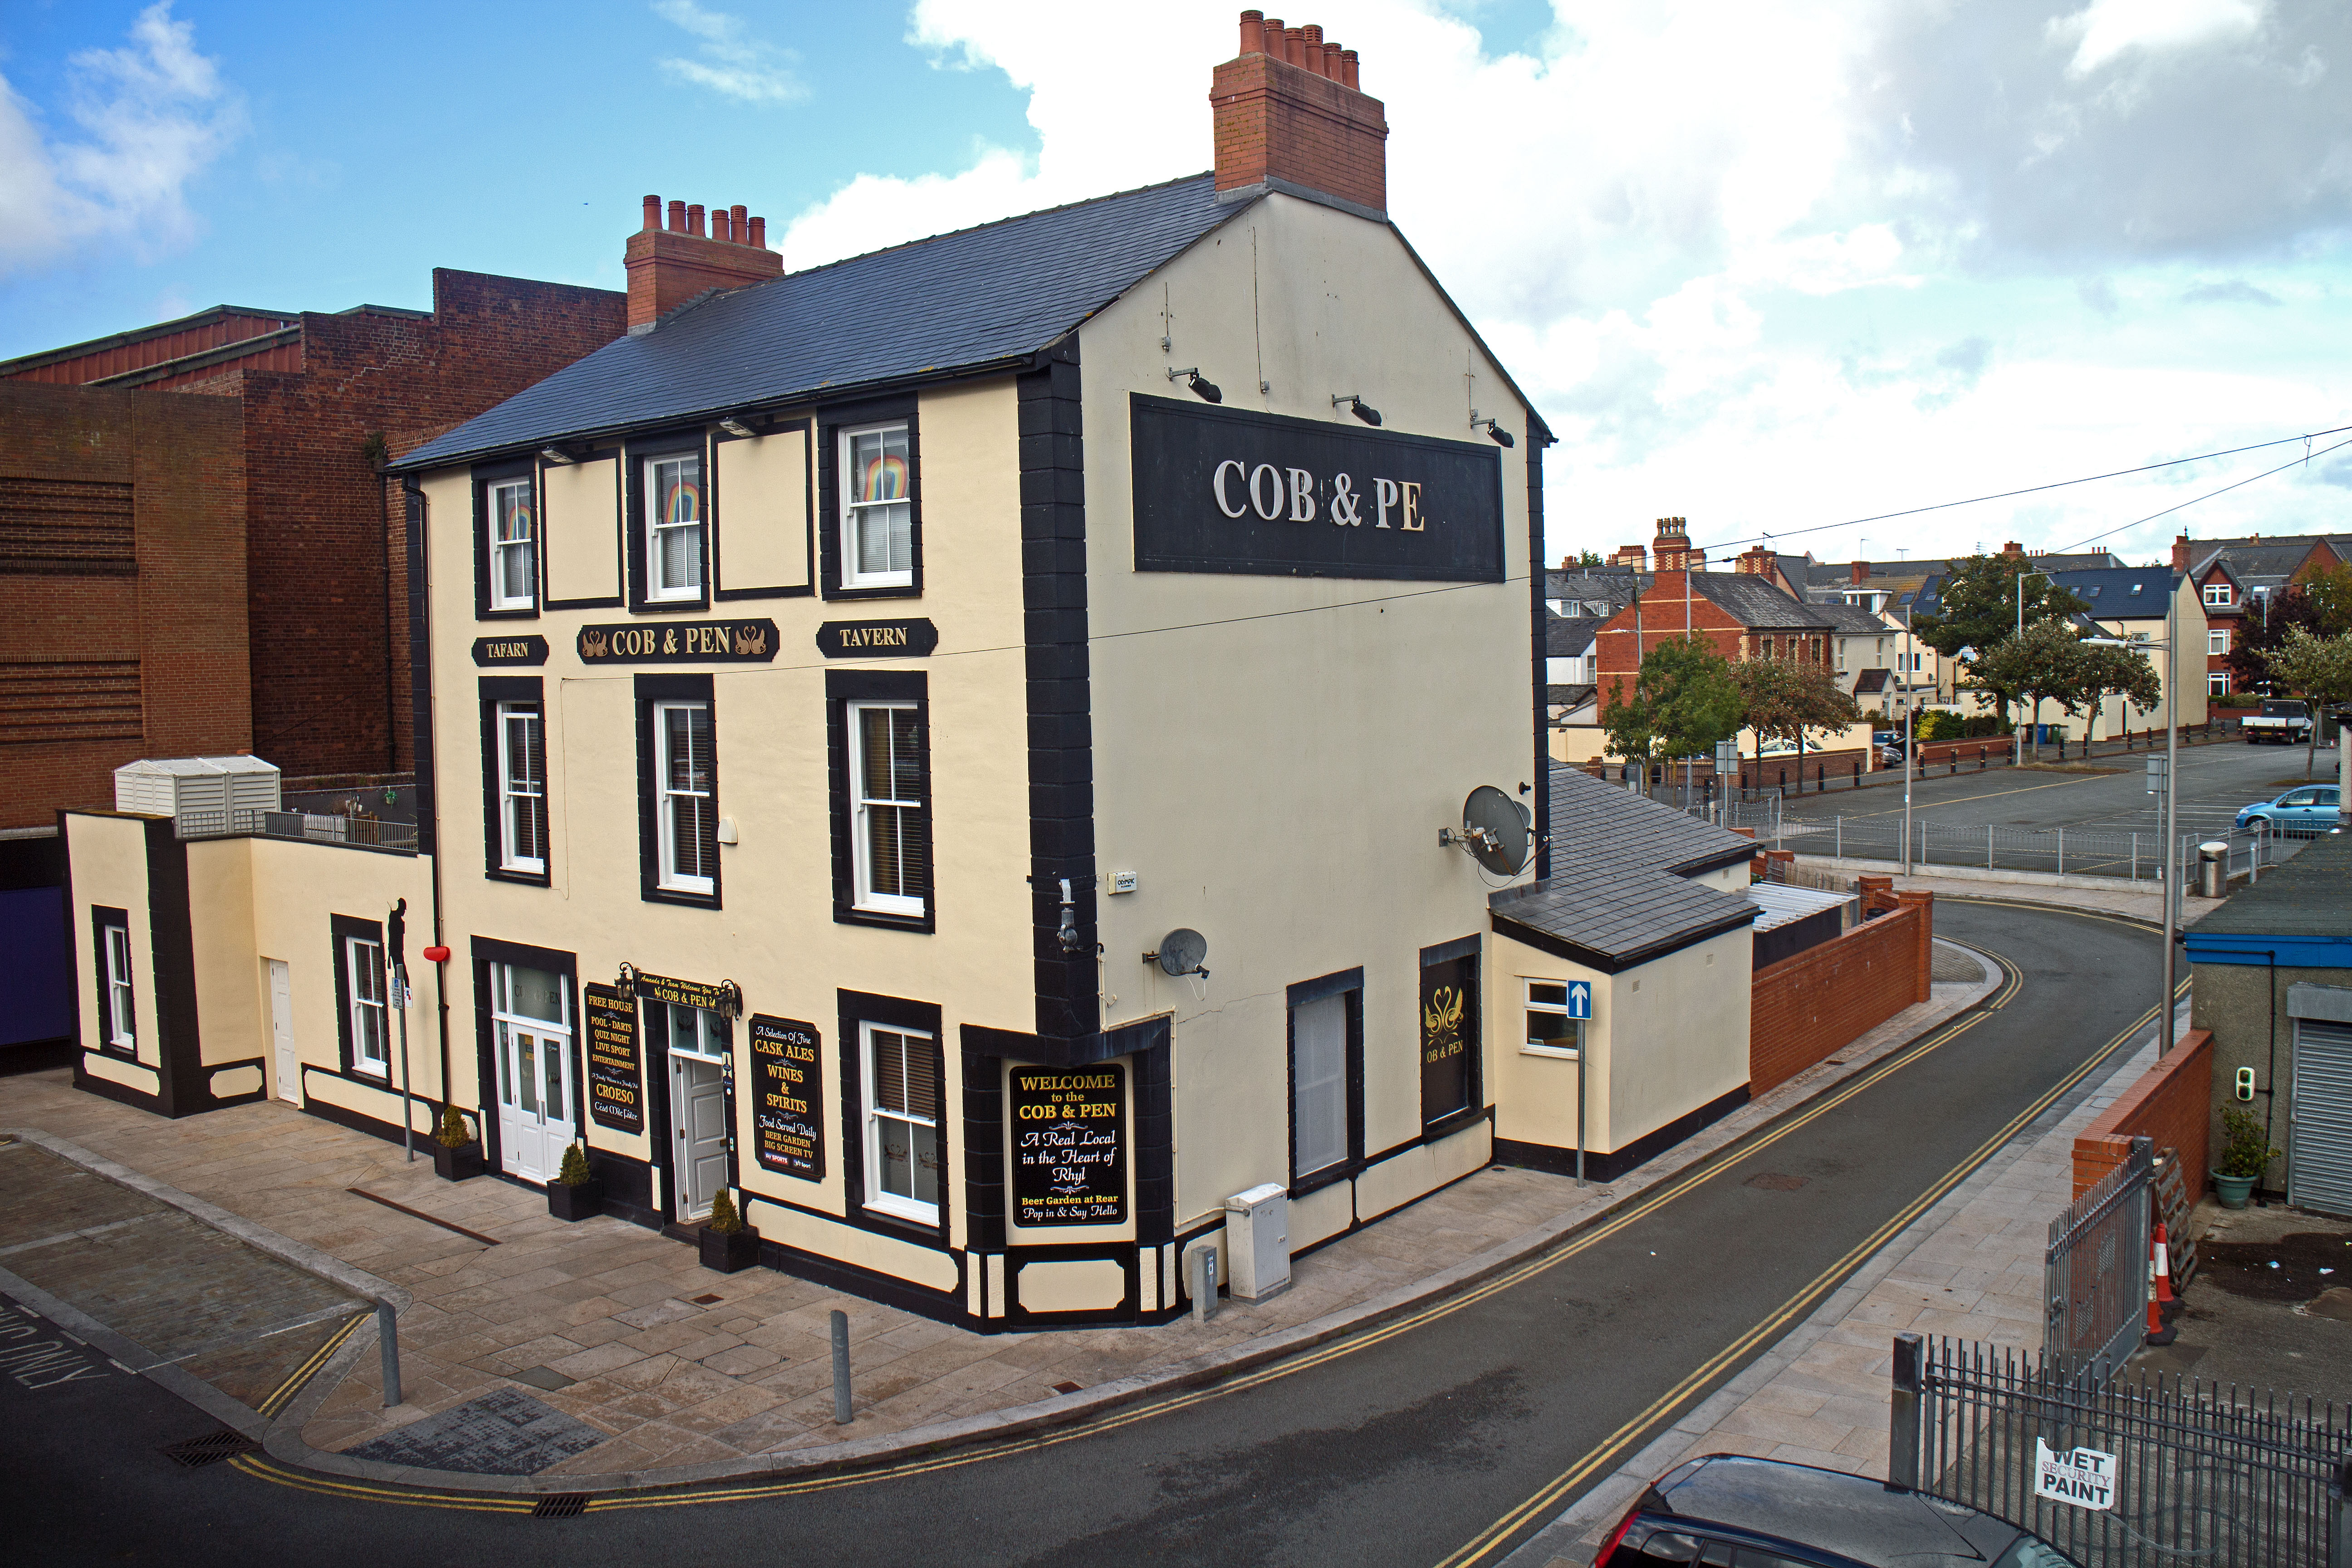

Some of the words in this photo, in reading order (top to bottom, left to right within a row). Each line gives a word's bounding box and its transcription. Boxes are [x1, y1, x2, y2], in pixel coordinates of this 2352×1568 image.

[1214, 460, 1316, 522] COB
[1330, 473, 1362, 527] &
[1373, 477, 1425, 532] PE
[612, 629, 656, 656] COB
[663, 629, 679, 655] &
[685, 626, 732, 654] PEN
[839, 627, 908, 647] TAVERN
[486, 642, 529, 658] TAFARN
[640, 975, 660, 985] Amanda
[666, 979, 679, 988] Team
[681, 981, 701, 993] Welcome
[702, 986, 711, 995] You
[713, 987, 720, 995] To
[588, 995, 607, 1008] FREE
[608, 999, 633, 1013] HOUSE
[662, 989, 679, 1002] COB
[681, 992, 688, 1004] &
[691, 994, 707, 1008] PEN
[591, 1016, 608, 1027] POOL
[612, 1020, 632, 1033] DARTS
[595, 1029, 610, 1040] QUIZ
[610, 1033, 630, 1044] NIGHT
[756, 1026, 764, 1035] A
[765, 1027, 787, 1040] Selection
[788, 1032, 796, 1044] Of
[797, 1033, 811, 1044] Fine
[595, 1041, 610, 1052] LIVE
[611, 1045, 631, 1057] SPORT
[755, 1039, 784, 1056] CASK
[786, 1045, 814, 1062] ALES
[1426, 1049, 1438, 1063] OB
[1440, 1046, 1446, 1058] &
[1449, 1039, 1463, 1056] PEN
[592, 1054, 635, 1070] ENTERTAINMENT
[767, 1064, 804, 1083] WINES
[1020, 1074, 1115, 1091] WELCOME
[596, 1083, 634, 1104] CROESO
[781, 1082, 789, 1095] &
[1052, 1093, 1063, 1102] to
[1066, 1092, 1084, 1102] the
[767, 1093, 807, 1113] SPIRITS
[1019, 1105, 1057, 1120] COB
[1062, 1104, 1075, 1118] &
[1080, 1103, 1117, 1117] PEN
[759, 1115, 774, 1128] Food
[776, 1119, 796, 1133] Served
[797, 1123, 816, 1142] Daily
[765, 1130, 782, 1142] BEER
[783, 1134, 810, 1148] GARDEN
[1020, 1132, 1039, 1147] A
[1043, 1131, 1075, 1147] Real
[1079, 1130, 1116, 1146] Local
[764, 1140, 775, 1150] BIG
[777, 1143, 802, 1156] SCREEN
[804, 1149, 813, 1159] TV
[772, 1154, 788, 1164] SPORTS
[1023, 1152, 1034, 1165] in
[1038, 1150, 1056, 1164] the
[1062, 1148, 1100, 1164] Heart
[1103, 1147, 1117, 1166] of
[1052, 1166, 1086, 1185] Rhyl
[1022, 1197, 1044, 1205] Beer
[1046, 1196, 1082, 1205] Garden
[1096, 1195, 1118, 1203] Rear
[1023, 1207, 1043, 1221] Pop
[1045, 1208, 1054, 1217] in
[1057, 1207, 1067, 1217] &
[1069, 1205, 1087, 1220] Say
[1091, 1204, 1117, 1216] Hello
[2053, 1451, 2105, 1473] WET
[2042, 1460, 2111, 1487] SECURITY
[2043, 1473, 2109, 1505] PAINT
